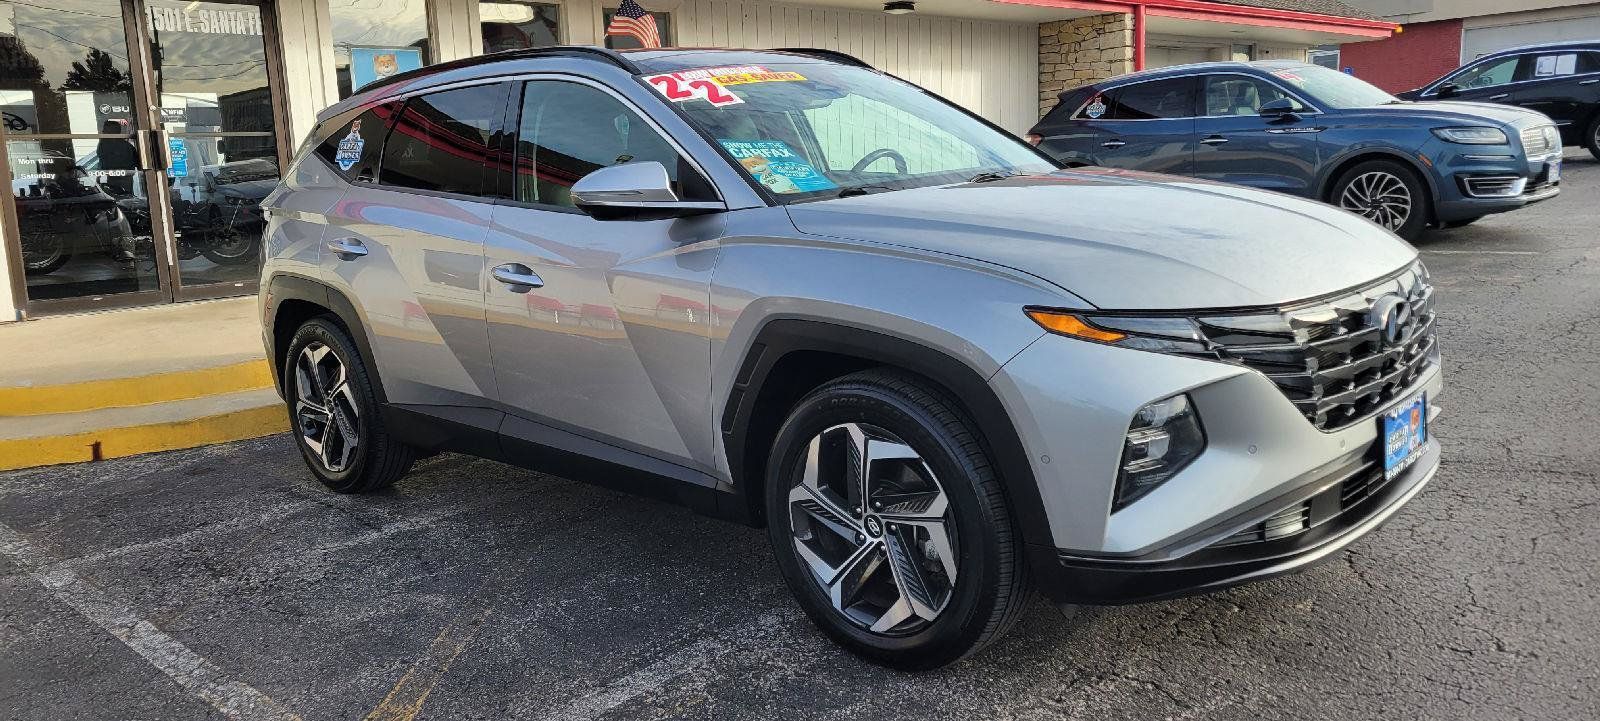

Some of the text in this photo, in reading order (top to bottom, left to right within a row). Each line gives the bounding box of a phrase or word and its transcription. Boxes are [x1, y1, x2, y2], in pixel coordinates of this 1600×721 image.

[199, 9, 246, 35] SANTA
[715, 75, 748, 85] GAS
[751, 72, 799, 82] SAVER
[723, 141, 784, 149] SHOW ME THE
[728, 147, 796, 158] CARFAX
[20, 172, 56, 180] Saturday
